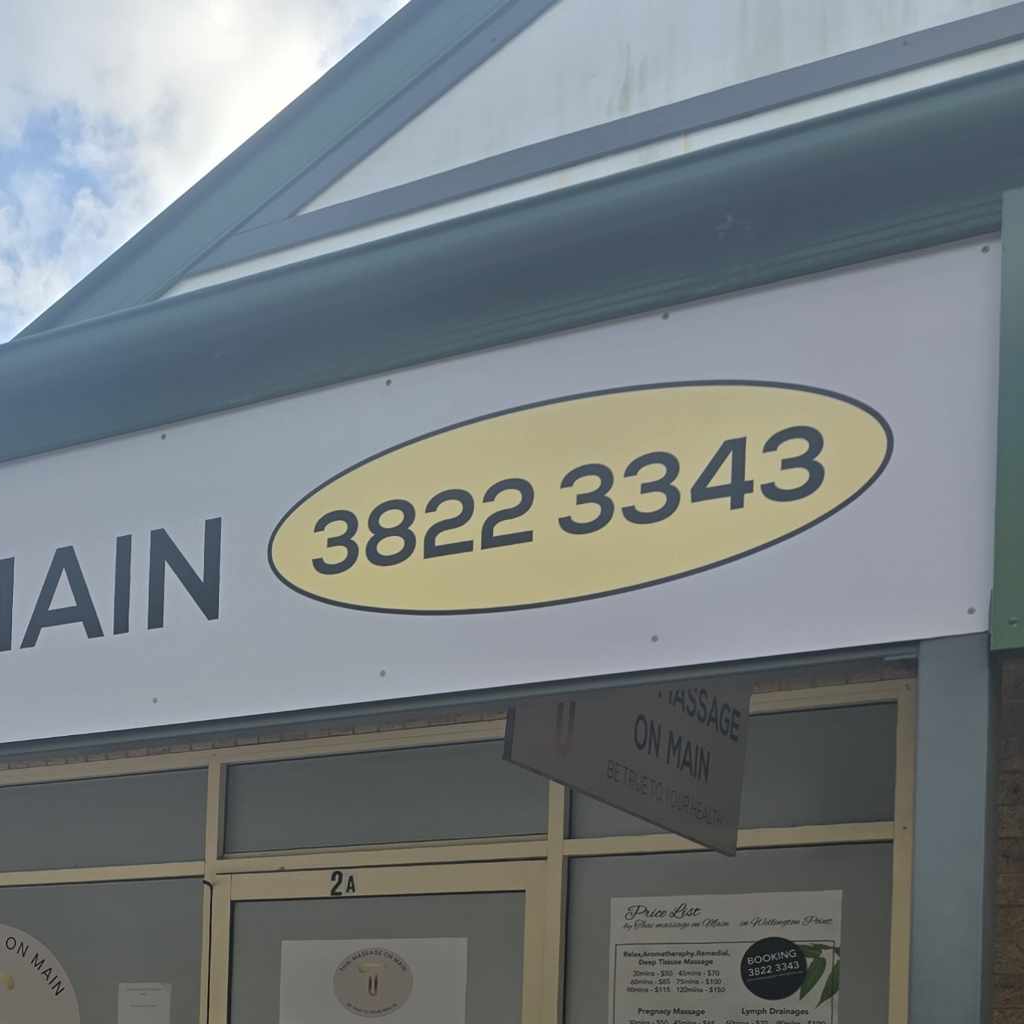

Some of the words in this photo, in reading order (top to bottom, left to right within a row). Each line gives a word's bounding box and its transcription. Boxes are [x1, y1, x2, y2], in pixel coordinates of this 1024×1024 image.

[310, 476, 536, 576] 3822
[556, 423, 826, 535] 3343
[634, 713, 661, 758] ON
[663, 730, 711, 784] MAIN
[330, 870, 356, 896] 2A
[624, 904, 668, 921] Price
[669, 902, 702, 920] List
[5, 935, 29, 958] ON
[31, 953, 65, 997] MAIN
[638, 959, 657, 967] Deep
[658, 958, 682, 966] Tissue
[683, 958, 714, 967] Massage
[747, 949, 797, 965] BOOKING
[748, 964, 773, 977] 3822
[775, 960, 800, 972] 3343
[673, 1008, 706, 1017] Massage
[741, 1007, 767, 1017] Lymph
[769, 1007, 809, 1017] Drainages
